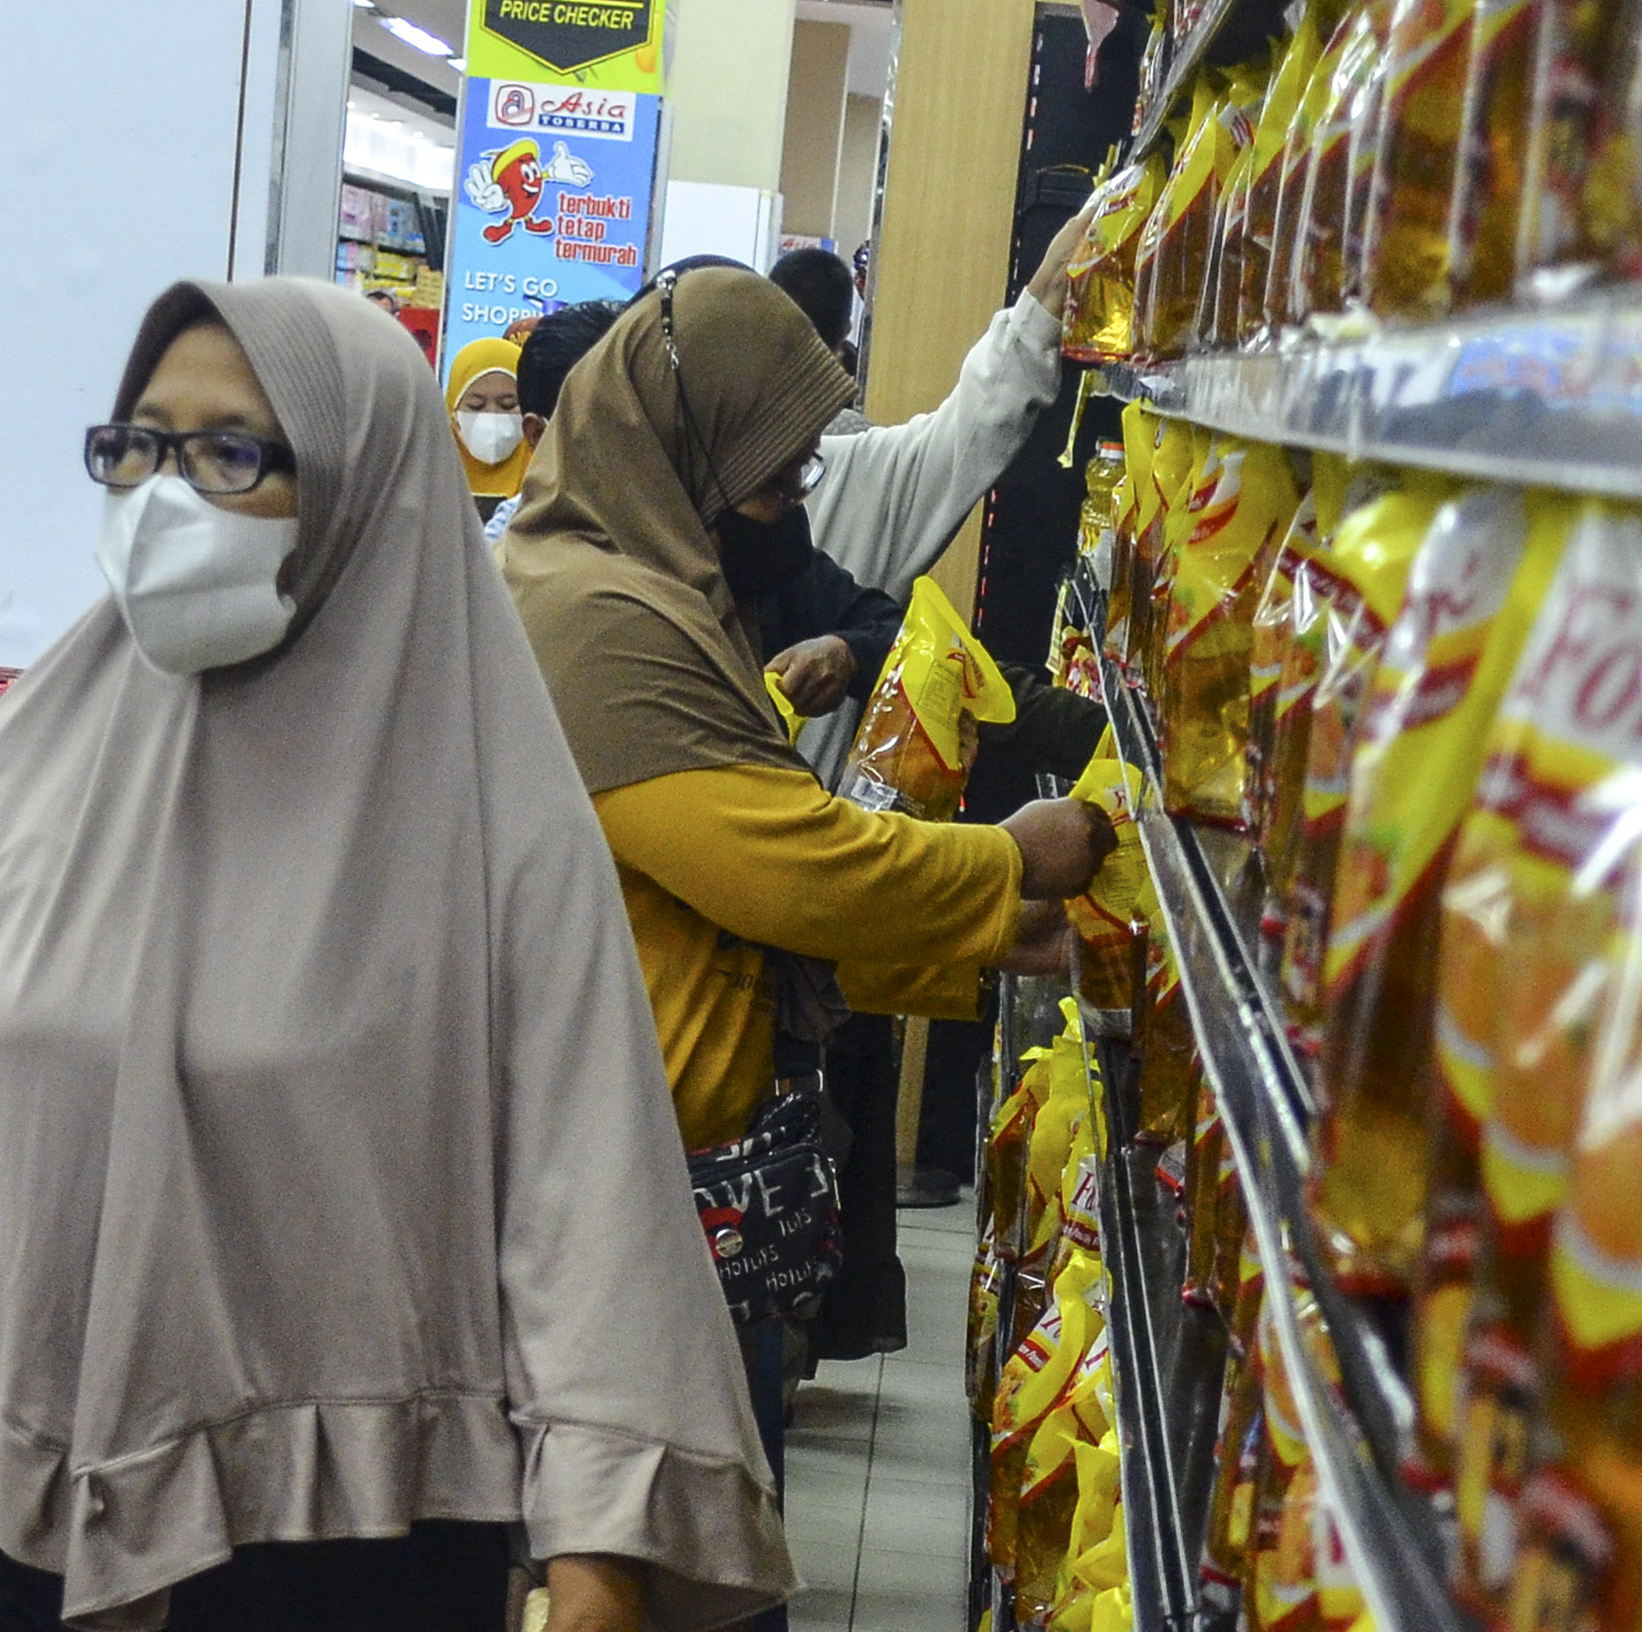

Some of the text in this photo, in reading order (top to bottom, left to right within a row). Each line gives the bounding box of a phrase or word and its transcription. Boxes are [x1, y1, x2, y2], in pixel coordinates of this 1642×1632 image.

[499, 1, 635, 31] PRICE CHECKER
[540, 91, 626, 118] Asia
[540, 116, 624, 133] TOSERBA
[559, 193, 631, 220] terbukti
[557, 215, 605, 241] tetap
[555, 238, 637, 265] termurah
[464, 270, 557, 298] LET'S GO
[460, 302, 543, 325] SHOPP
